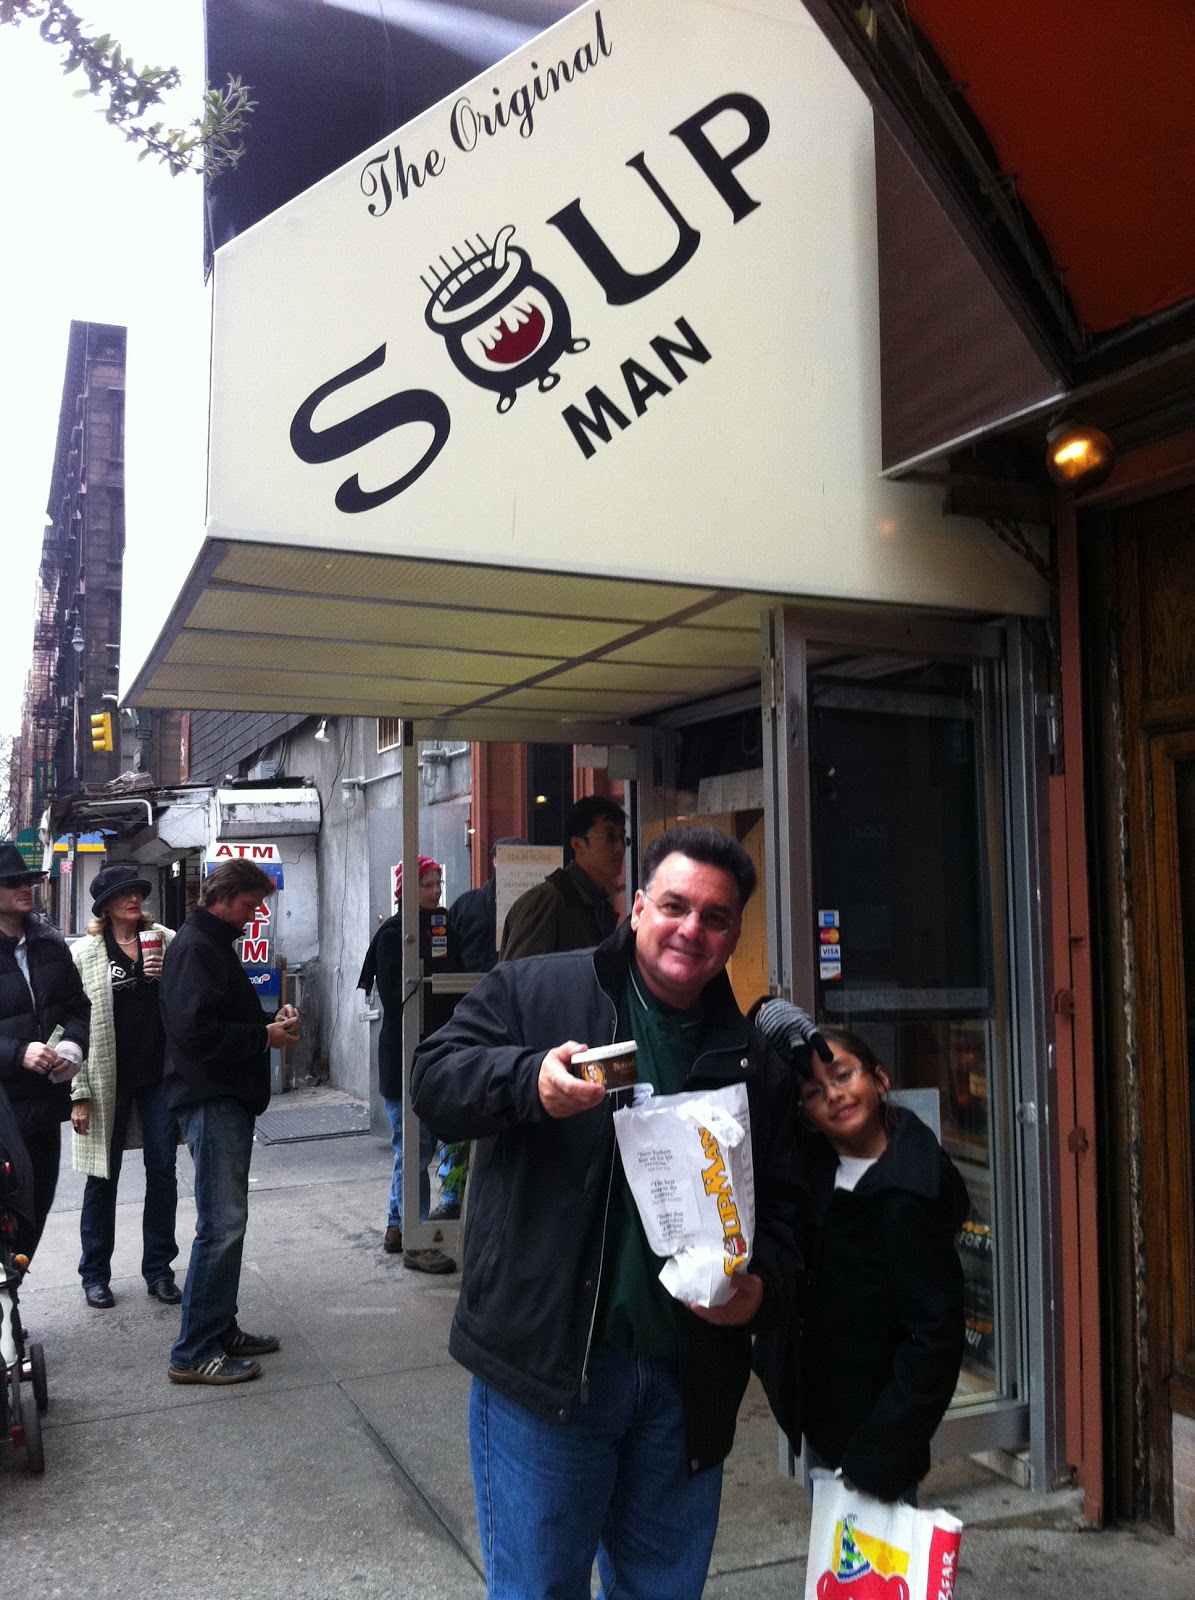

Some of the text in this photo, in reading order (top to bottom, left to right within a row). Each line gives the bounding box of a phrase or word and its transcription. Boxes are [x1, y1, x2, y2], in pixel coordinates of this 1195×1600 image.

[360, 9, 613, 218] The Original
[562, 316, 713, 460] MAN
[215, 844, 274, 859] ATM
[822, 948, 839, 956] VISA
